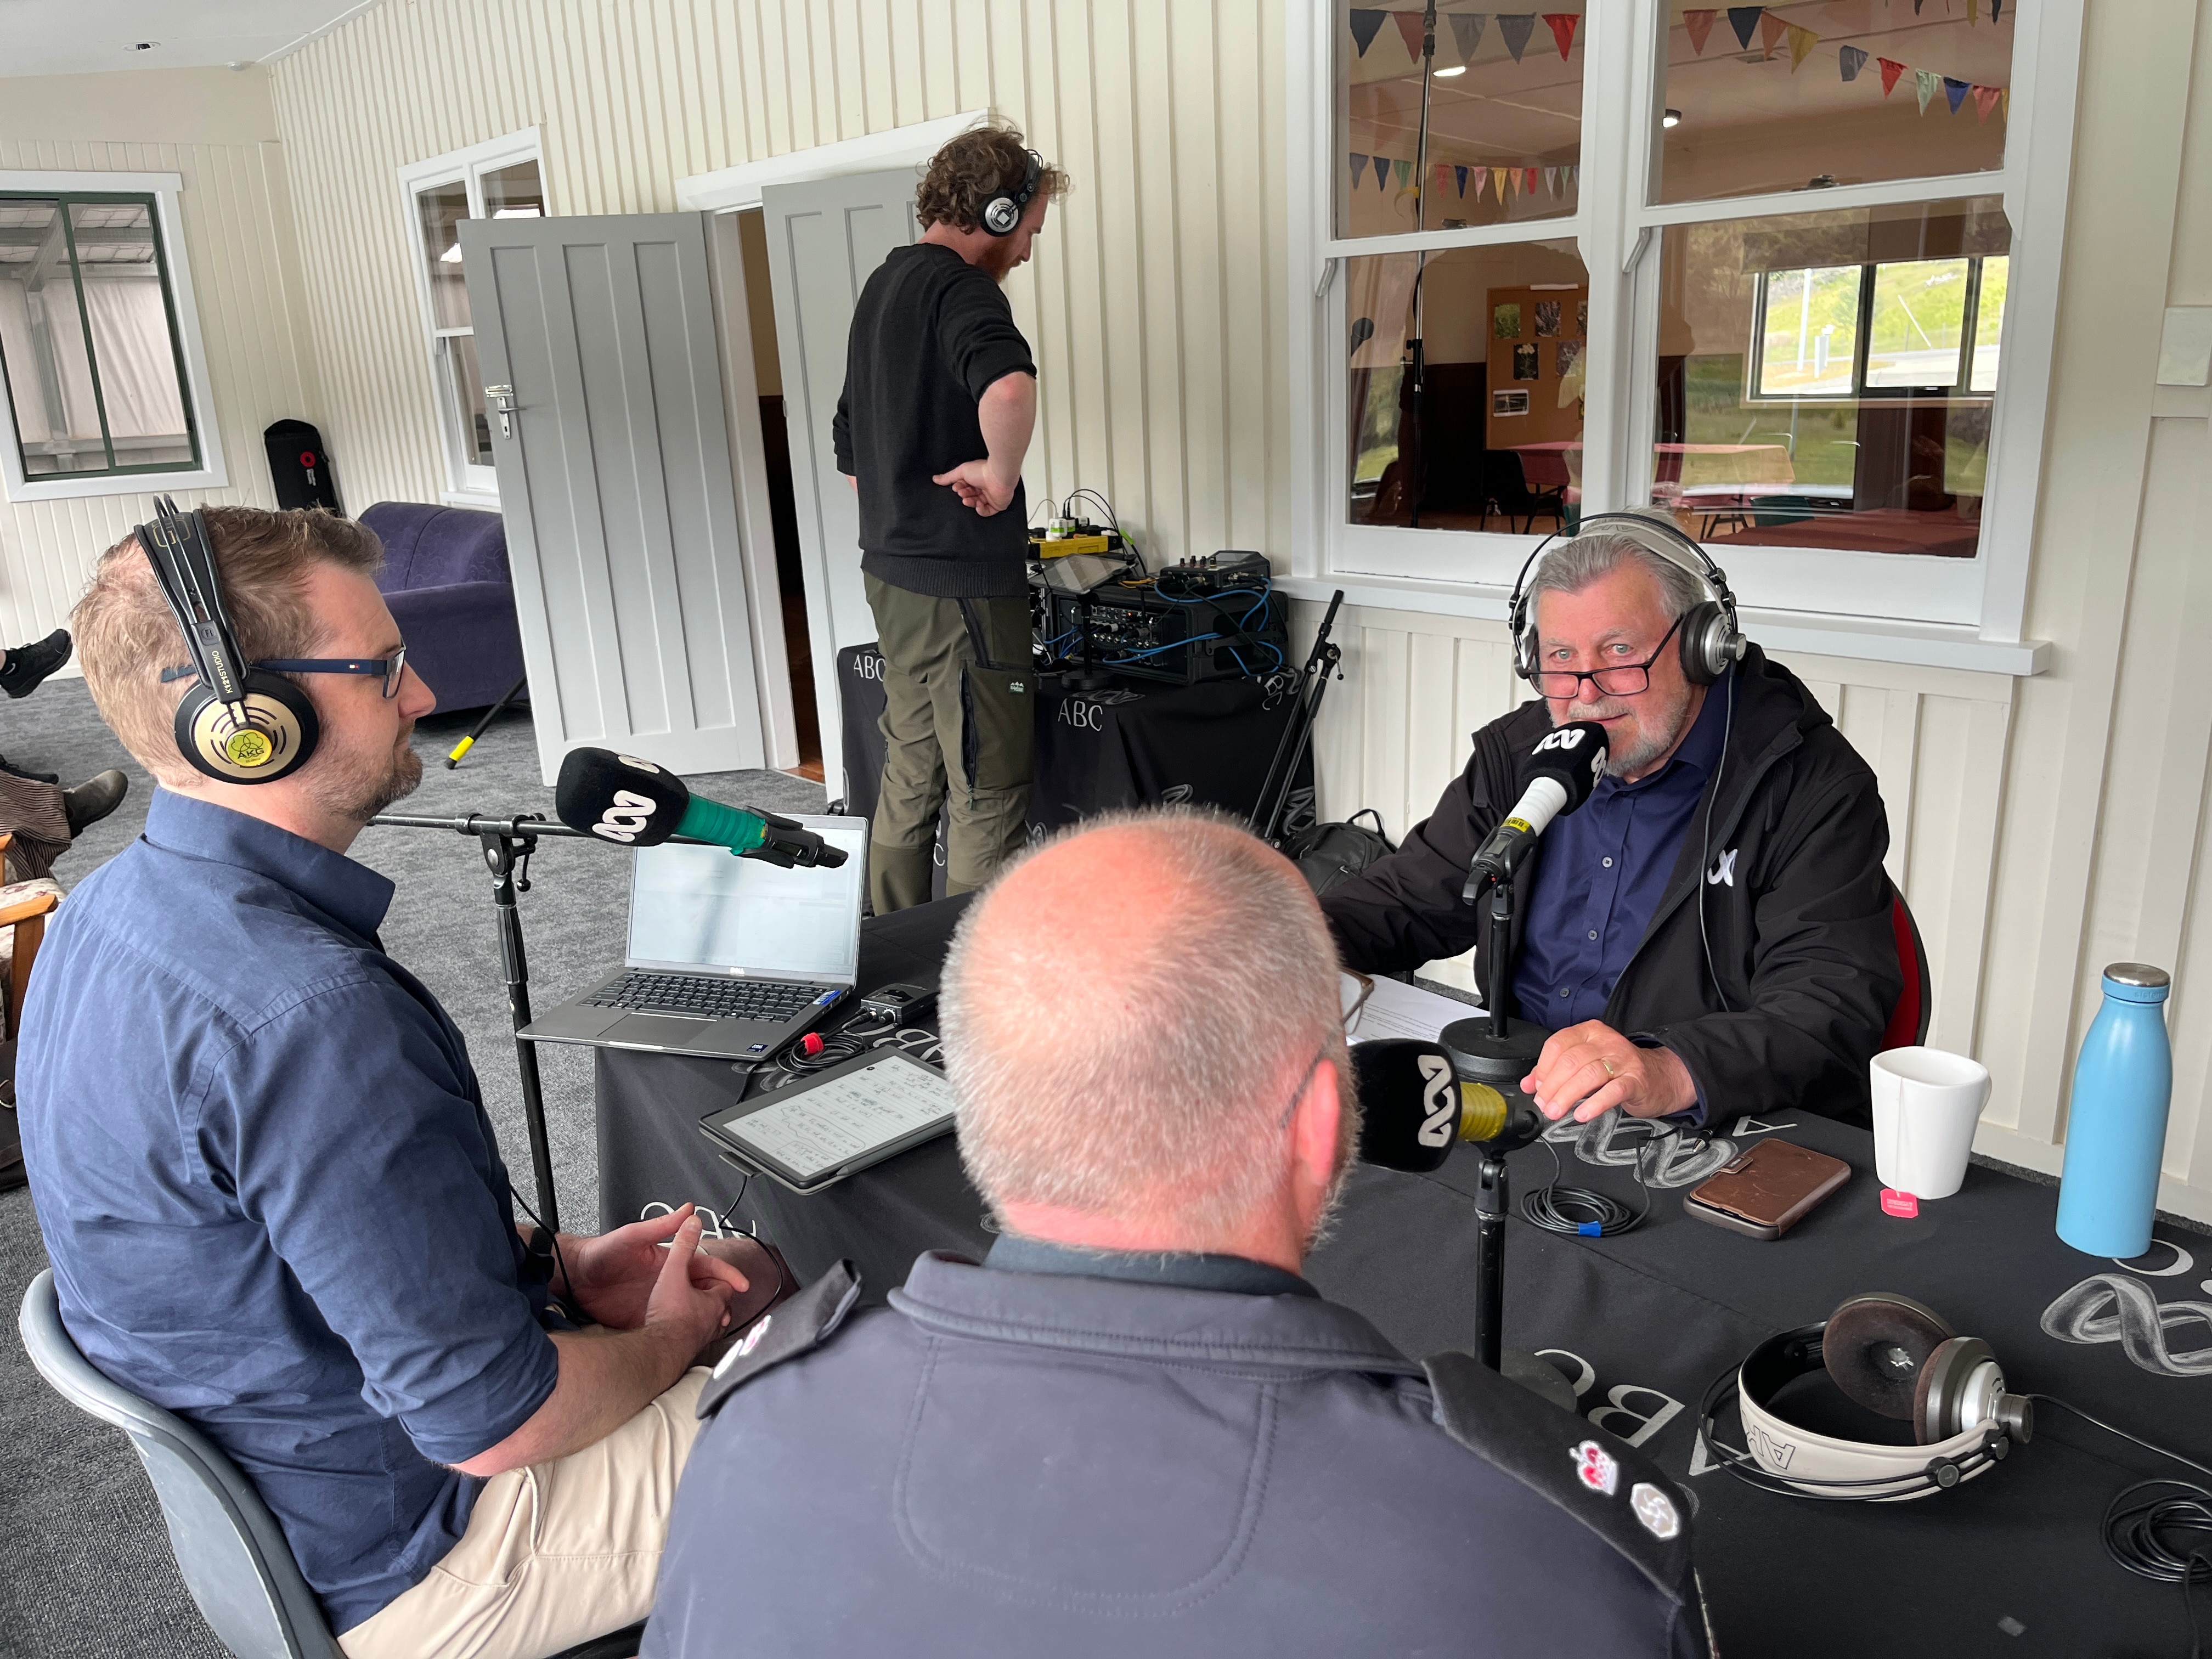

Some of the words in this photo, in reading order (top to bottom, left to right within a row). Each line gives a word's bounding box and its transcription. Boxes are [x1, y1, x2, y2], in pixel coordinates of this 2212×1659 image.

[853, 654, 886, 682] ABC
[1058, 698, 1103, 731] ABC
[238, 747, 264, 759] AKG
